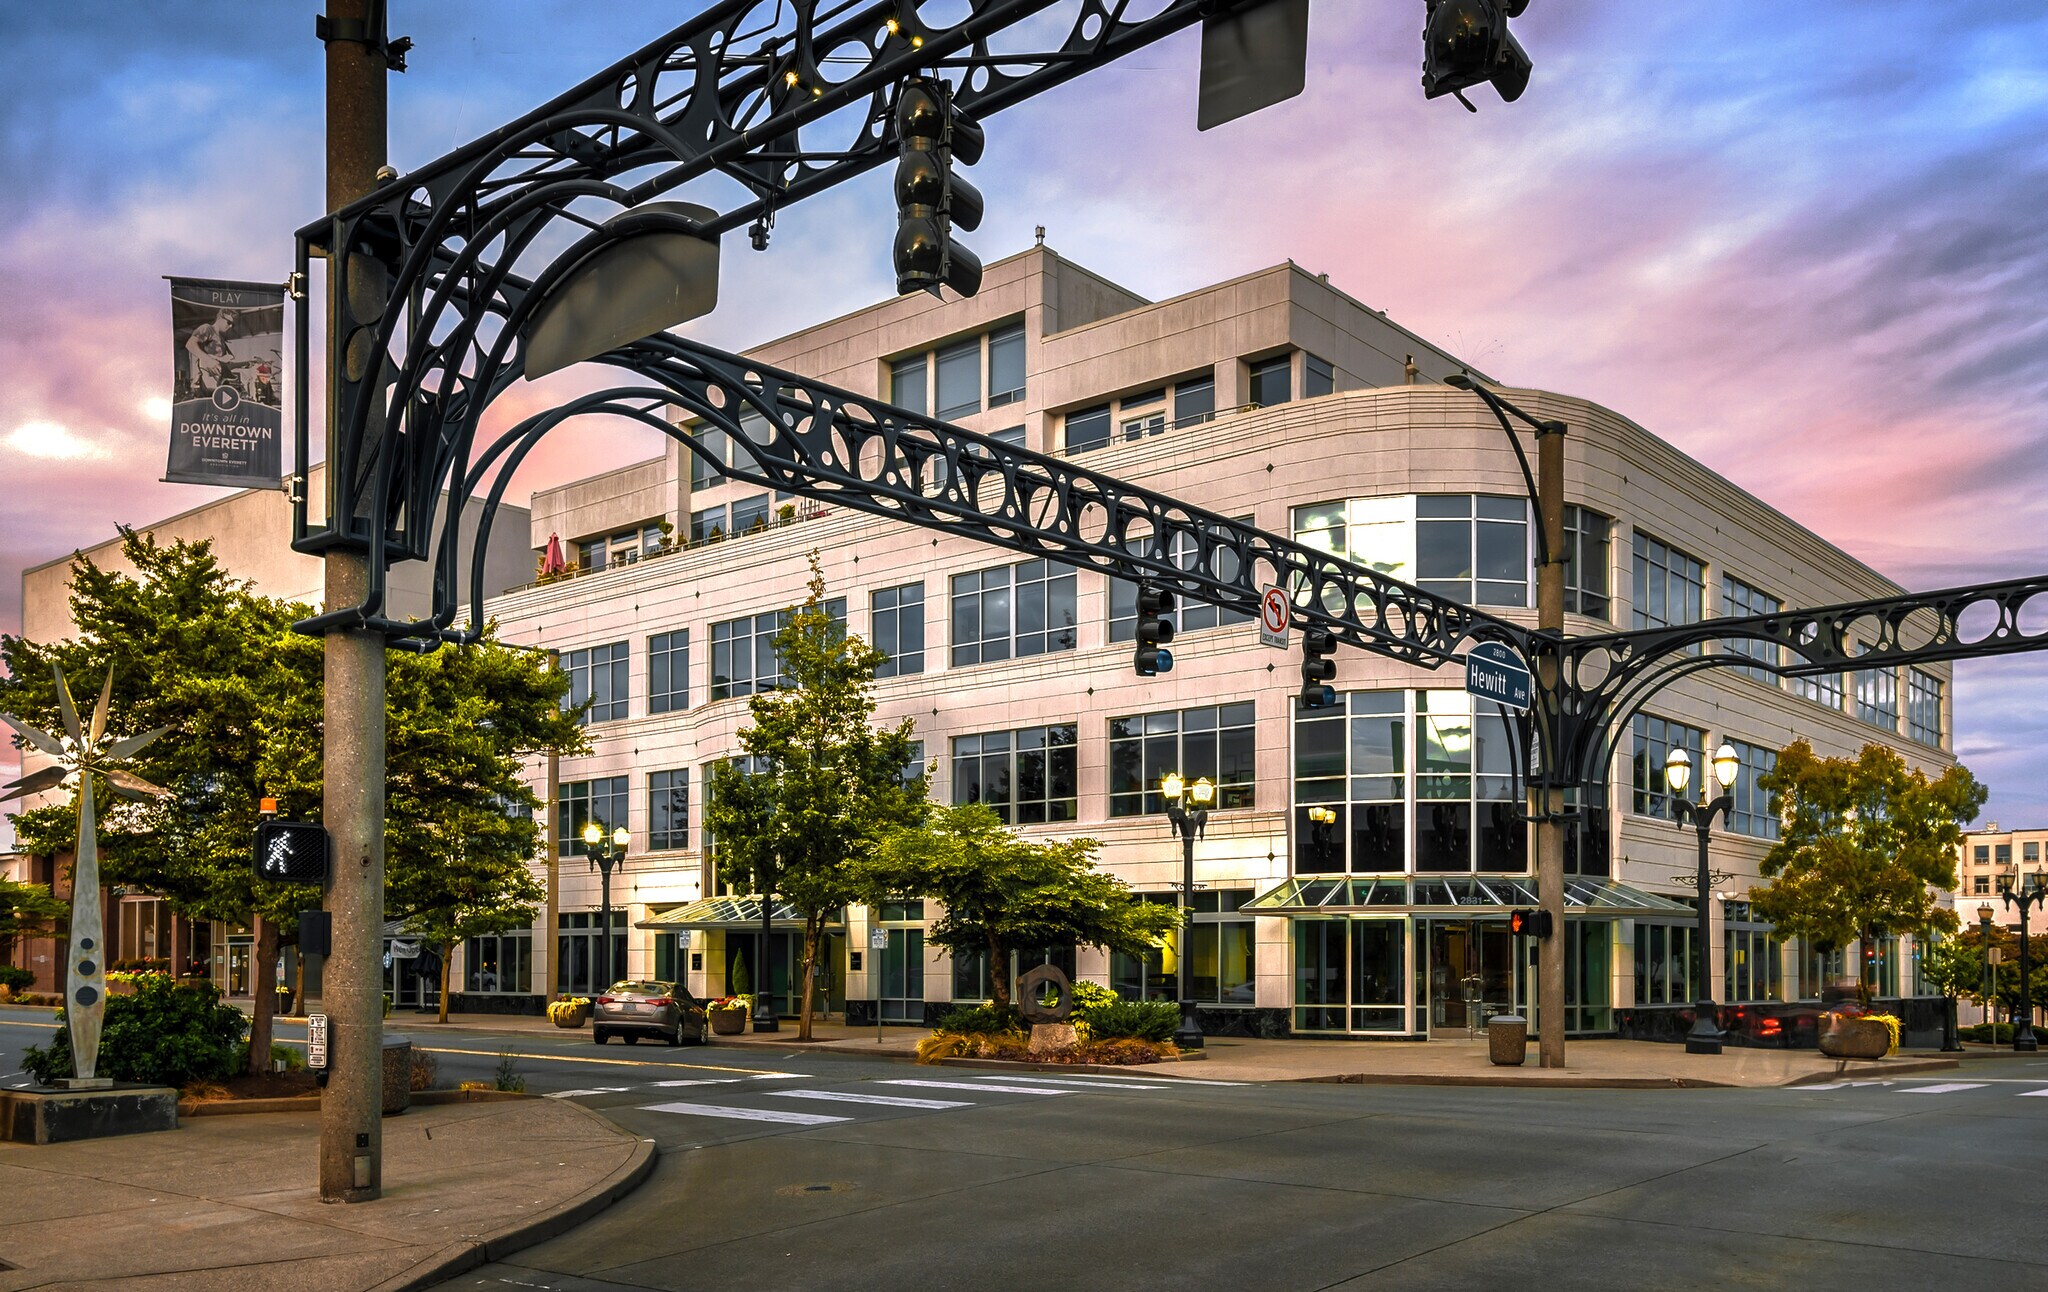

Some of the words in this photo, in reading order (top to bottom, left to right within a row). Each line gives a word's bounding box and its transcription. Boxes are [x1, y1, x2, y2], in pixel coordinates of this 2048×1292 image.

[212, 291, 242, 304] PLAY
[222, 414, 237, 423] all
[239, 415, 250, 424] in
[180, 422, 272, 439] DOWNTOWN
[192, 437, 258, 451] EVERETT
[1493, 648, 1506, 659] 2800
[1471, 664, 1506, 694] Hewitt
[1513, 687, 1526, 700] Ave
